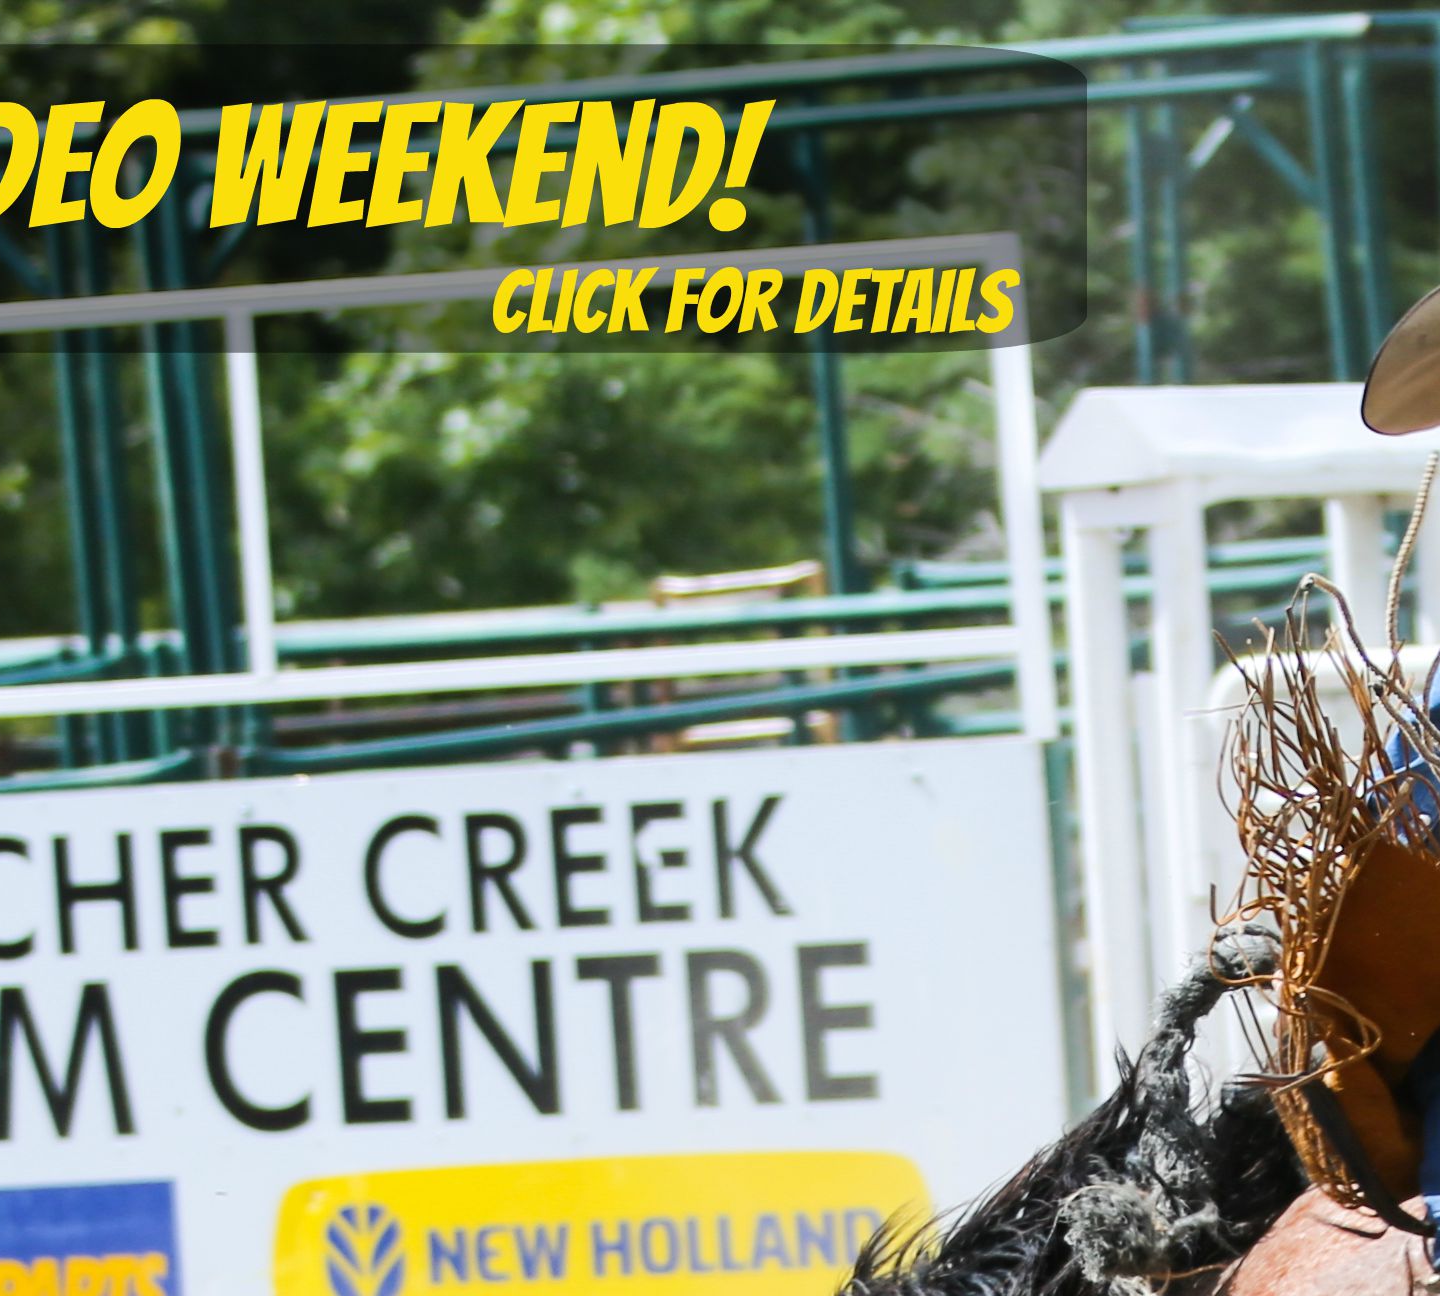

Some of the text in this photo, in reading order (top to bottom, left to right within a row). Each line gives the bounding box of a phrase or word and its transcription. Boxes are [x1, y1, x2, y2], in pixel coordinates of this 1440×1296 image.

[363, 792, 795, 940] CREEK
[203, 940, 881, 1133] CENTRE
[426, 1206, 884, 1286] NEW HOLLAND
